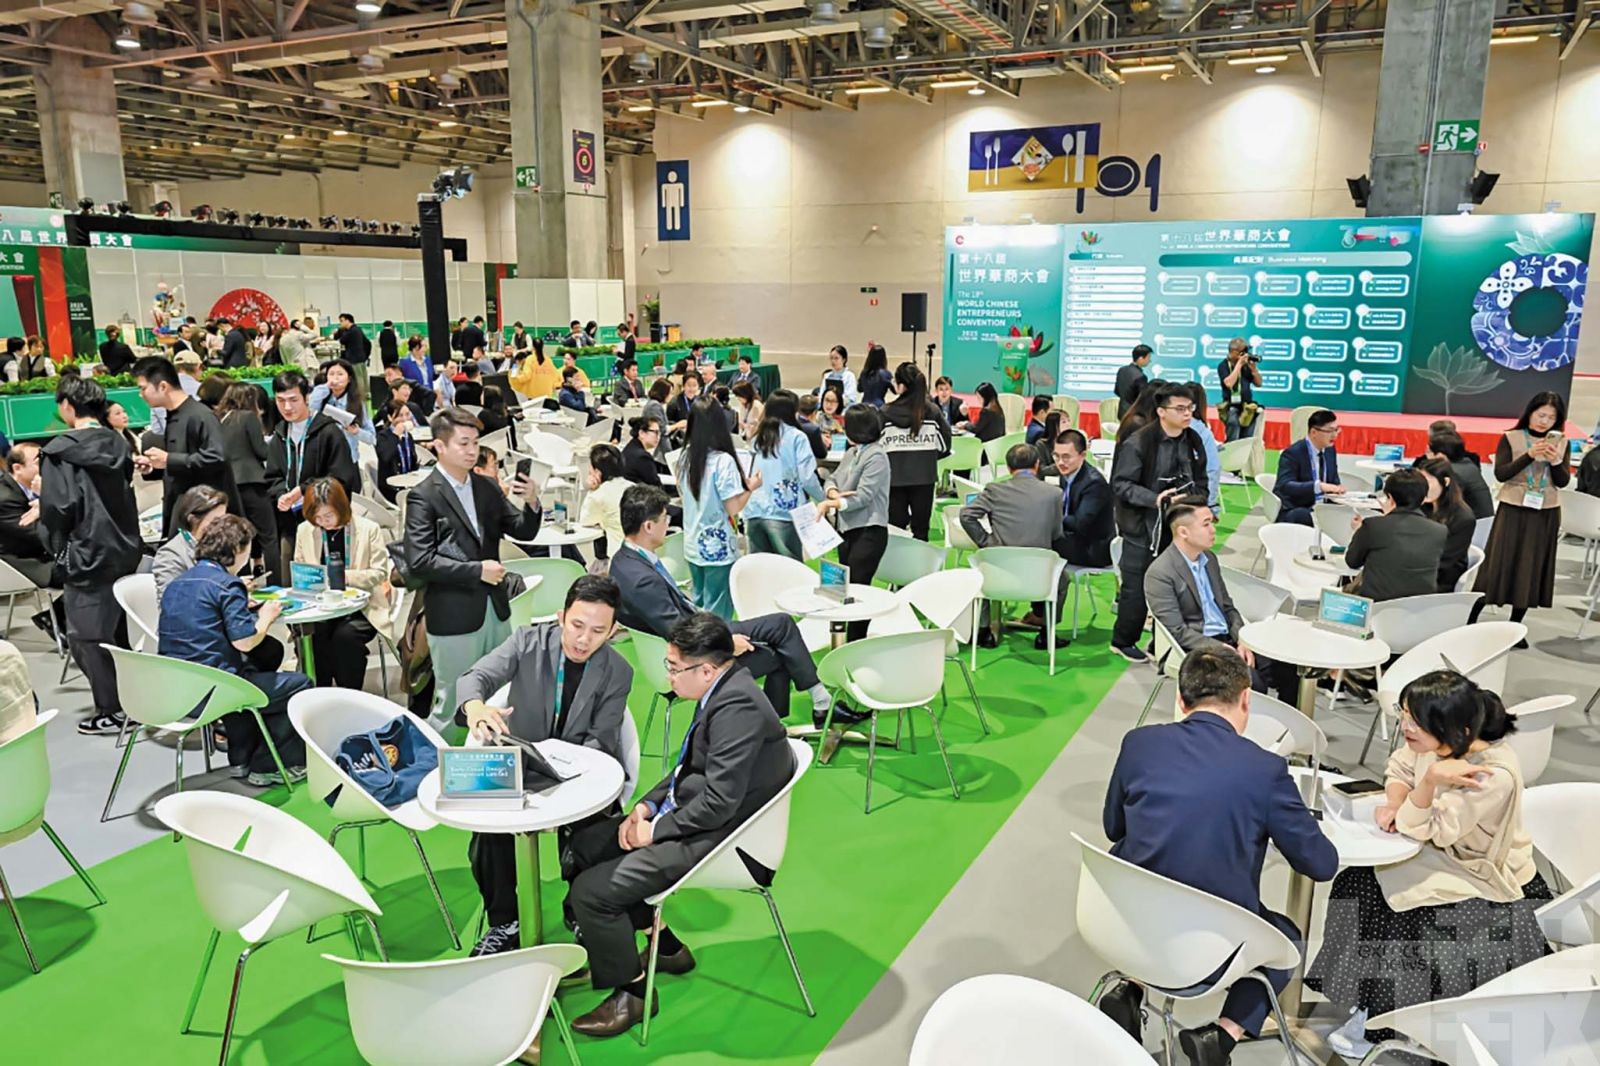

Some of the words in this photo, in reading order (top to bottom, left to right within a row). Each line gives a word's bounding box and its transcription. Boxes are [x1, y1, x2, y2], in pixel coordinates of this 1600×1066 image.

[958, 268, 1050, 284] 世界華商大會
[957, 300, 984, 308] WORLD
[986, 300, 1019, 308] CHINESE
[957, 309, 1022, 318] ENTREPRENEURS
[957, 318, 1006, 327] CONVENTION
